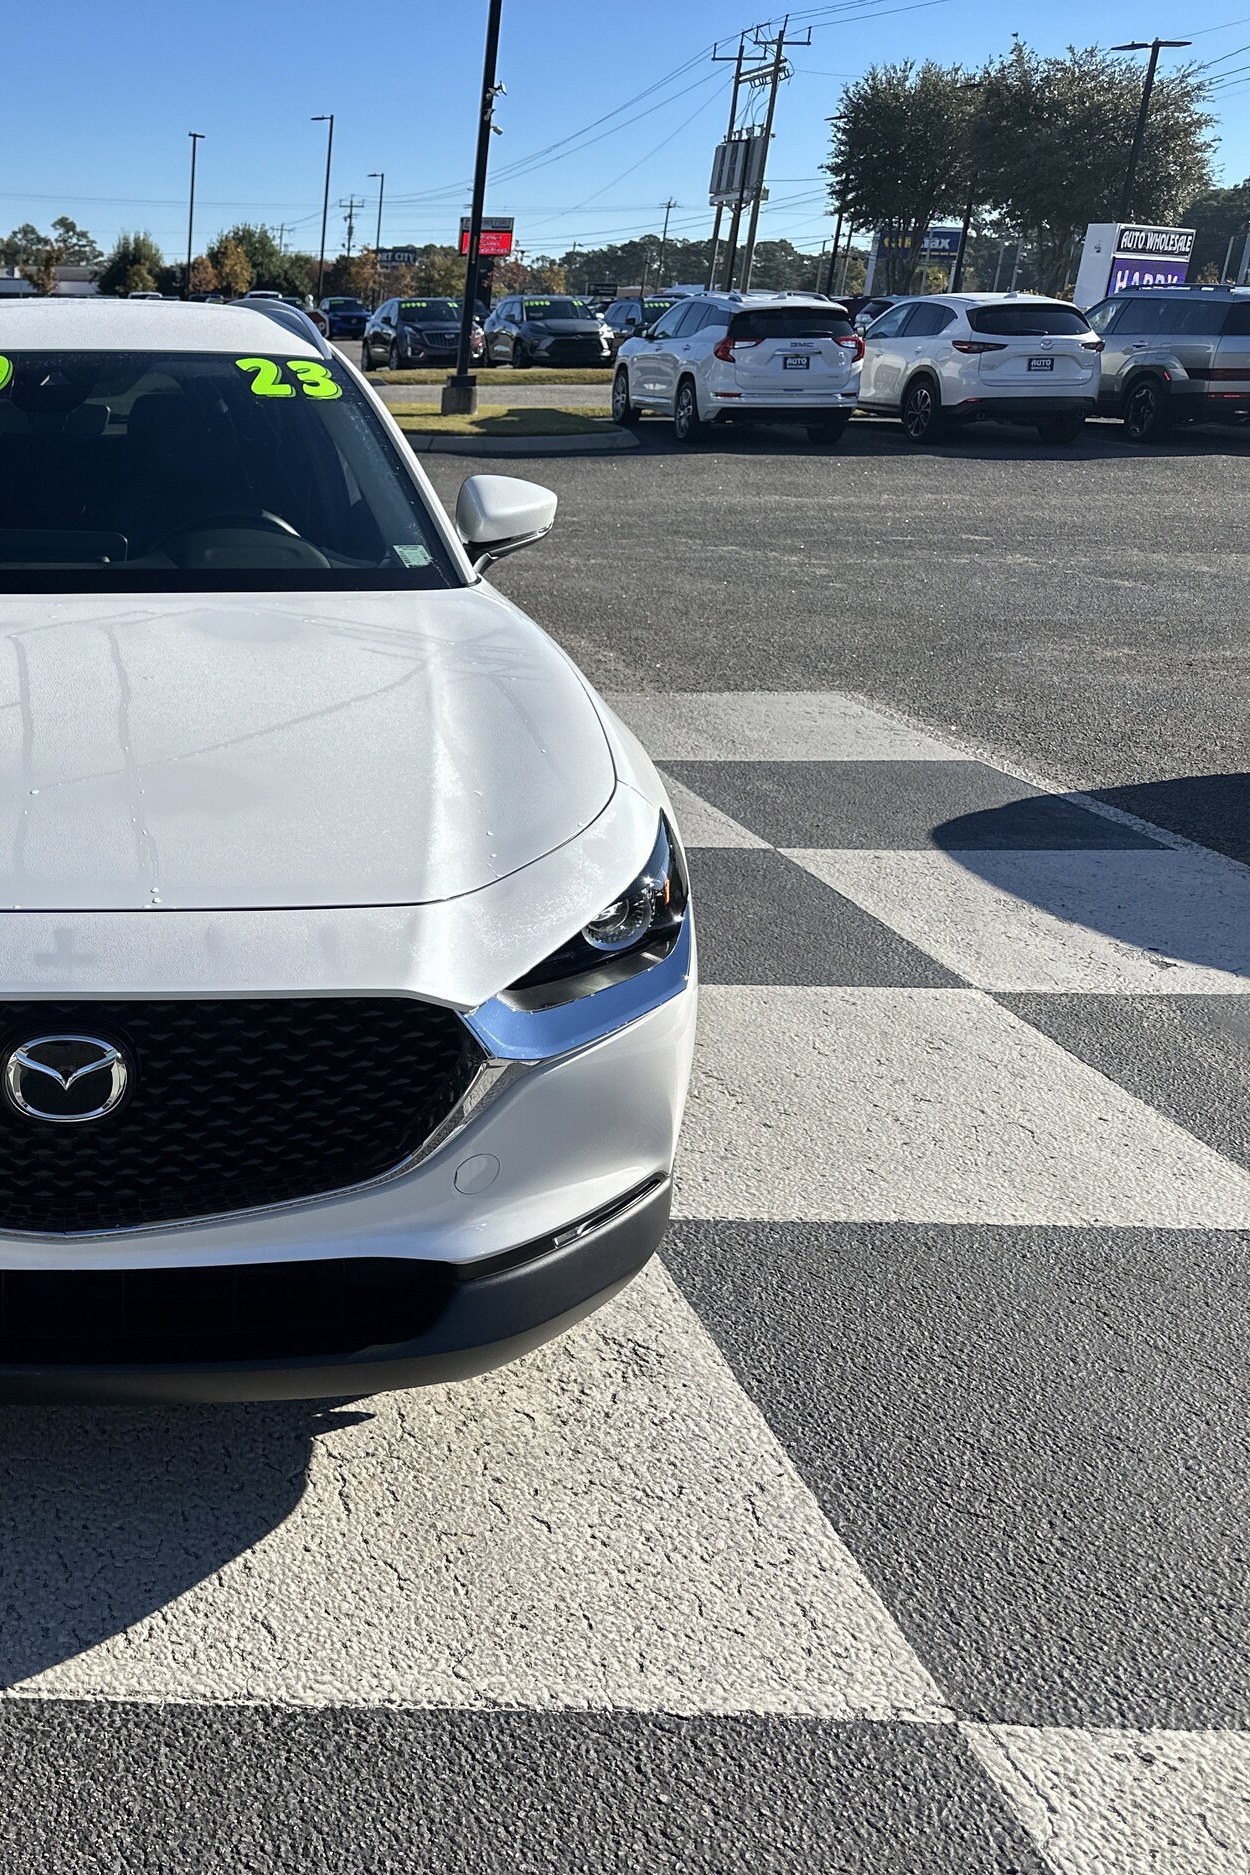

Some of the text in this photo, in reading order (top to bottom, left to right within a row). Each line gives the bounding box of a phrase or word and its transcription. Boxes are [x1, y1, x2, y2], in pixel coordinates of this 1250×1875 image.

[1120, 230, 1193, 254] AUTO WHOLESALE
[394, 252, 415, 262] CITY
[786, 357, 807, 365] AUTO
[234, 356, 343, 401] 23
